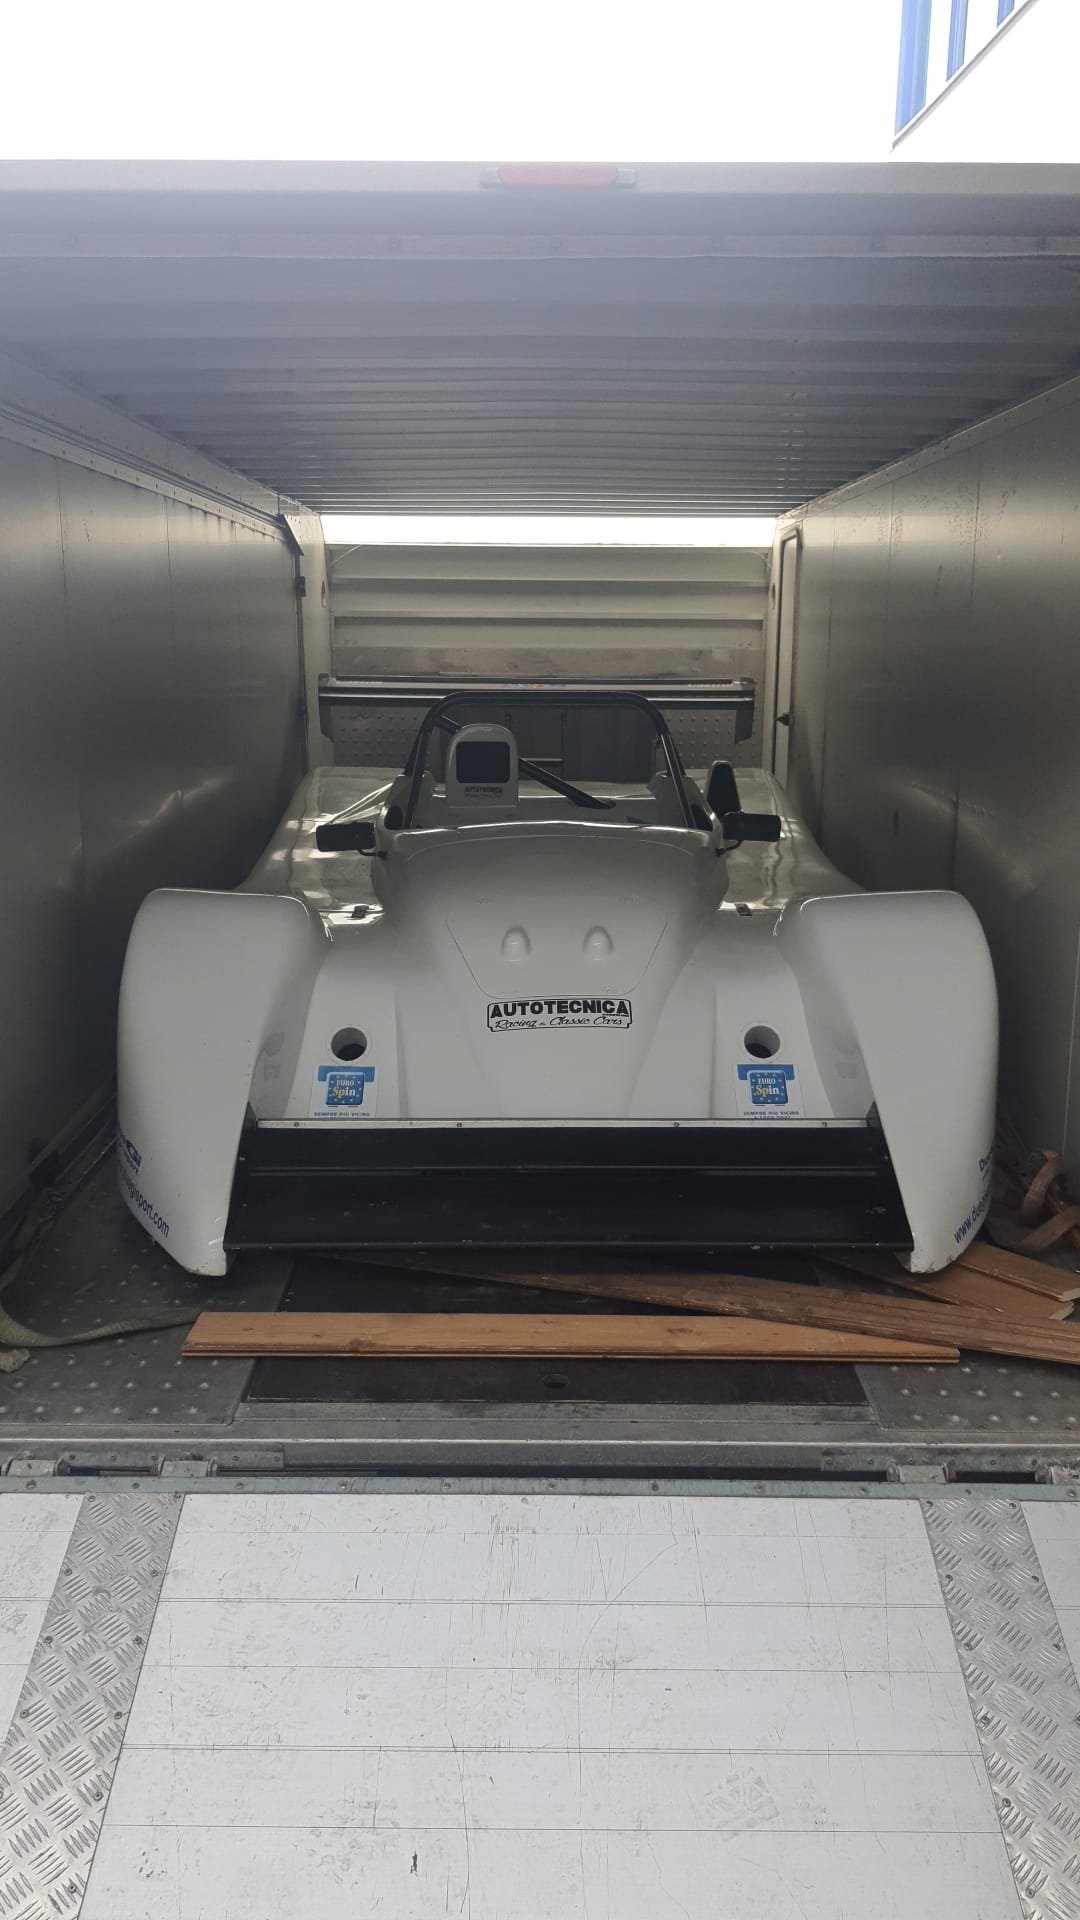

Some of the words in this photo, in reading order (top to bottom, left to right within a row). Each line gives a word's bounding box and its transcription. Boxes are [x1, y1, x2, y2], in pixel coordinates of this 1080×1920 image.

[490, 1000, 629, 1018] AUTOTECNICA
[495, 1019, 538, 1029] Racing
[549, 1015, 591, 1026] Classic
[593, 1015, 623, 1026] Cars
[336, 1079, 355, 1087] EURO
[757, 1077, 776, 1085] EURO
[333, 1086, 356, 1099] Spin
[755, 1084, 780, 1098] Spin
